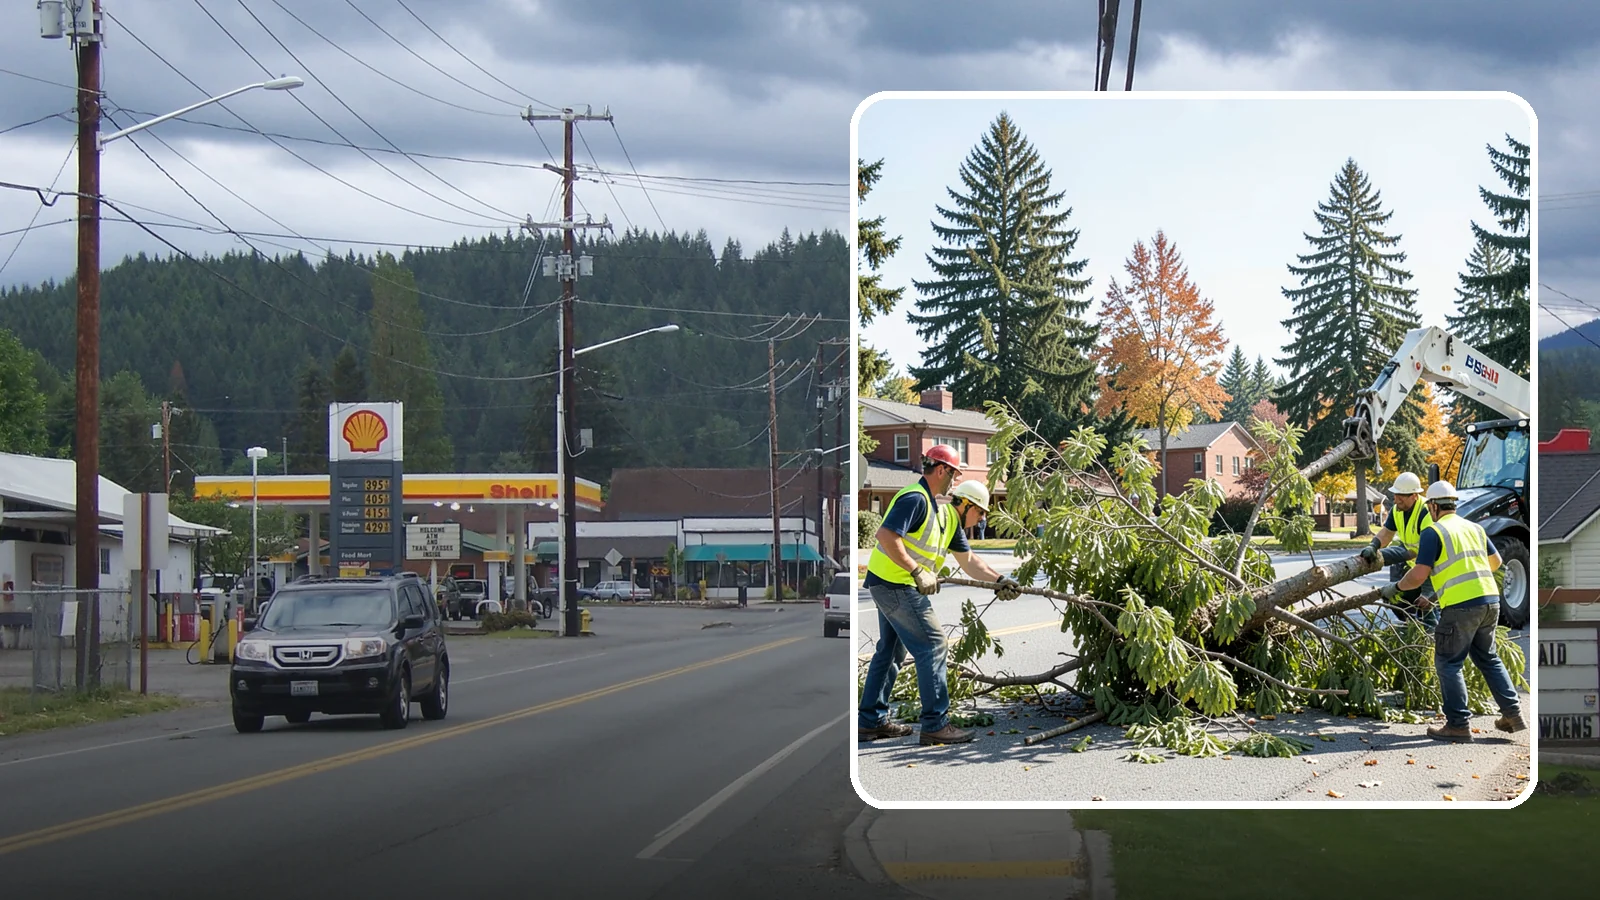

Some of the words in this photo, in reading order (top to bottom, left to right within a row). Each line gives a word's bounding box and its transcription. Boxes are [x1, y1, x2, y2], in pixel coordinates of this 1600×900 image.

[366, 480, 383, 490] 395
[489, 484, 547, 498] Shell
[366, 494, 383, 504] 405
[366, 508, 383, 518] 415
[366, 522, 383, 532] 429
[1538, 643, 1567, 665] AID
[1538, 716, 1592, 738] WKENS
